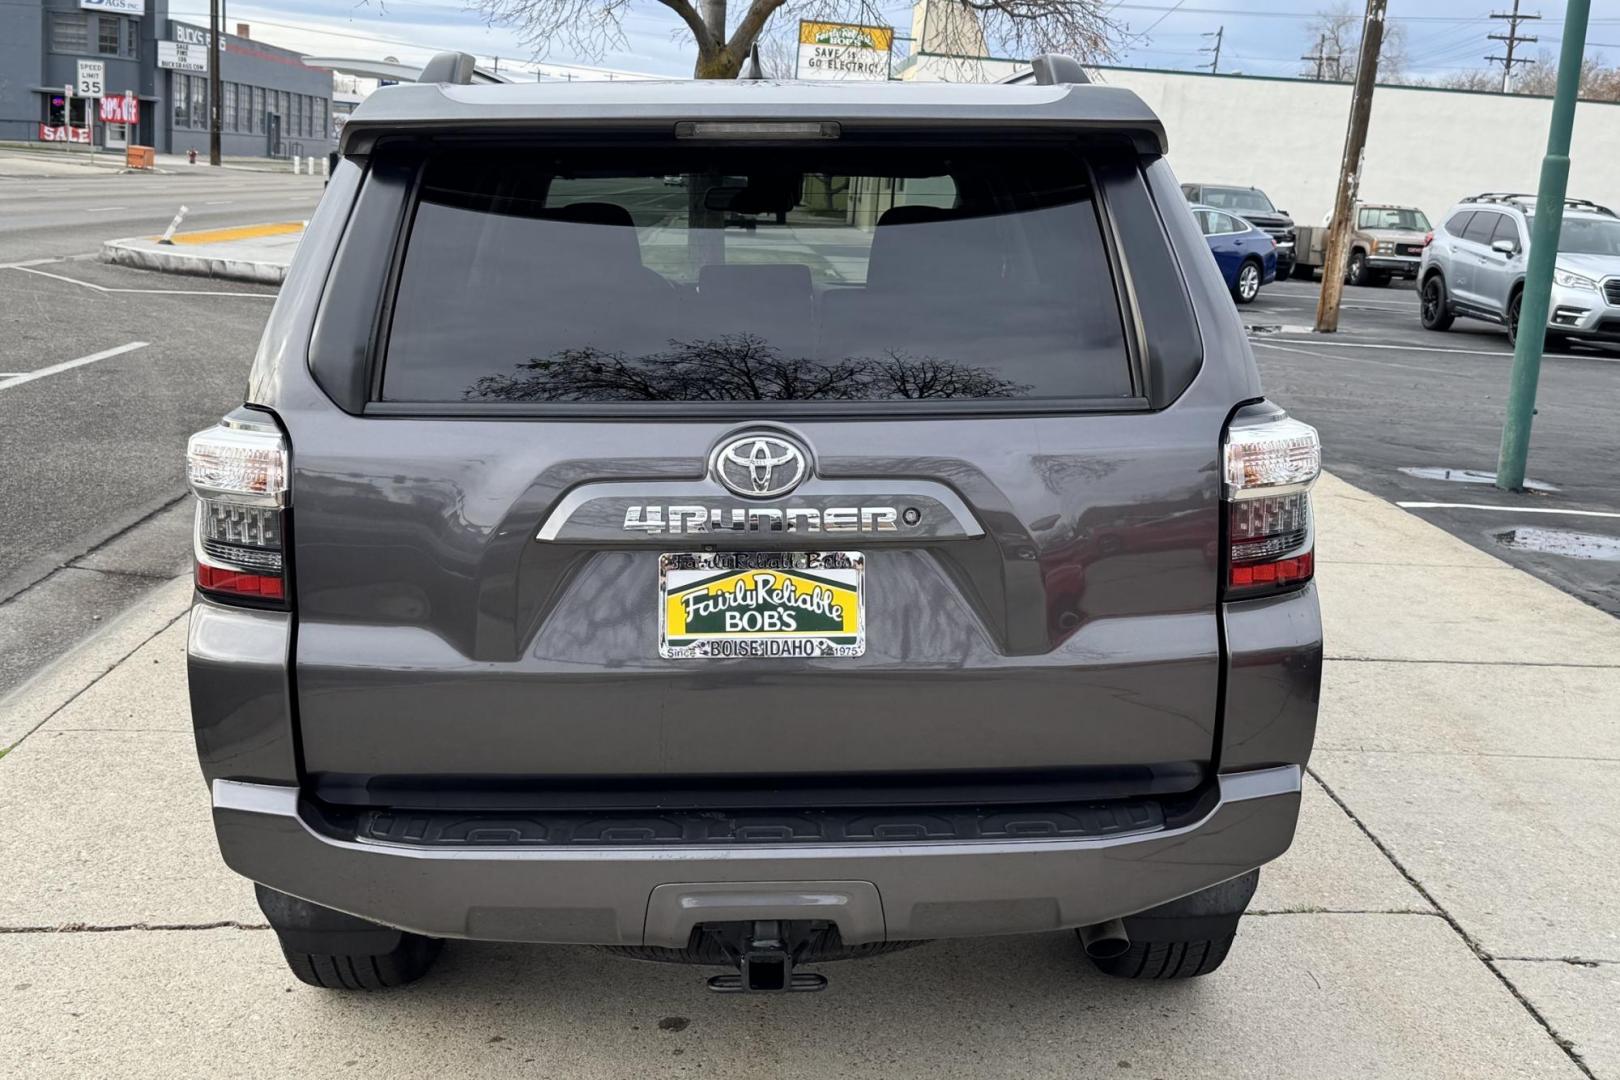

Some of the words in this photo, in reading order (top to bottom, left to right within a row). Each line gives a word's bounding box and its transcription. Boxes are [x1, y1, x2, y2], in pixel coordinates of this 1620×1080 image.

[177, 25, 204, 45] BUCKS
[815, 47, 840, 58] SAVE
[80, 63, 102, 71] SPEED
[808, 58, 822, 68] GO
[81, 81, 101, 93] 35
[100, 97, 121, 120] 30%
[43, 125, 90, 143] SALE
[623, 505, 897, 533] 4RUNNER
[681, 578, 757, 623] Fairly
[753, 572, 843, 622] Reliable
[725, 606, 798, 632] BOB'S
[667, 648, 697, 658] Since
[764, 639, 814, 656] IDAHO
[834, 646, 858, 656] 1975
